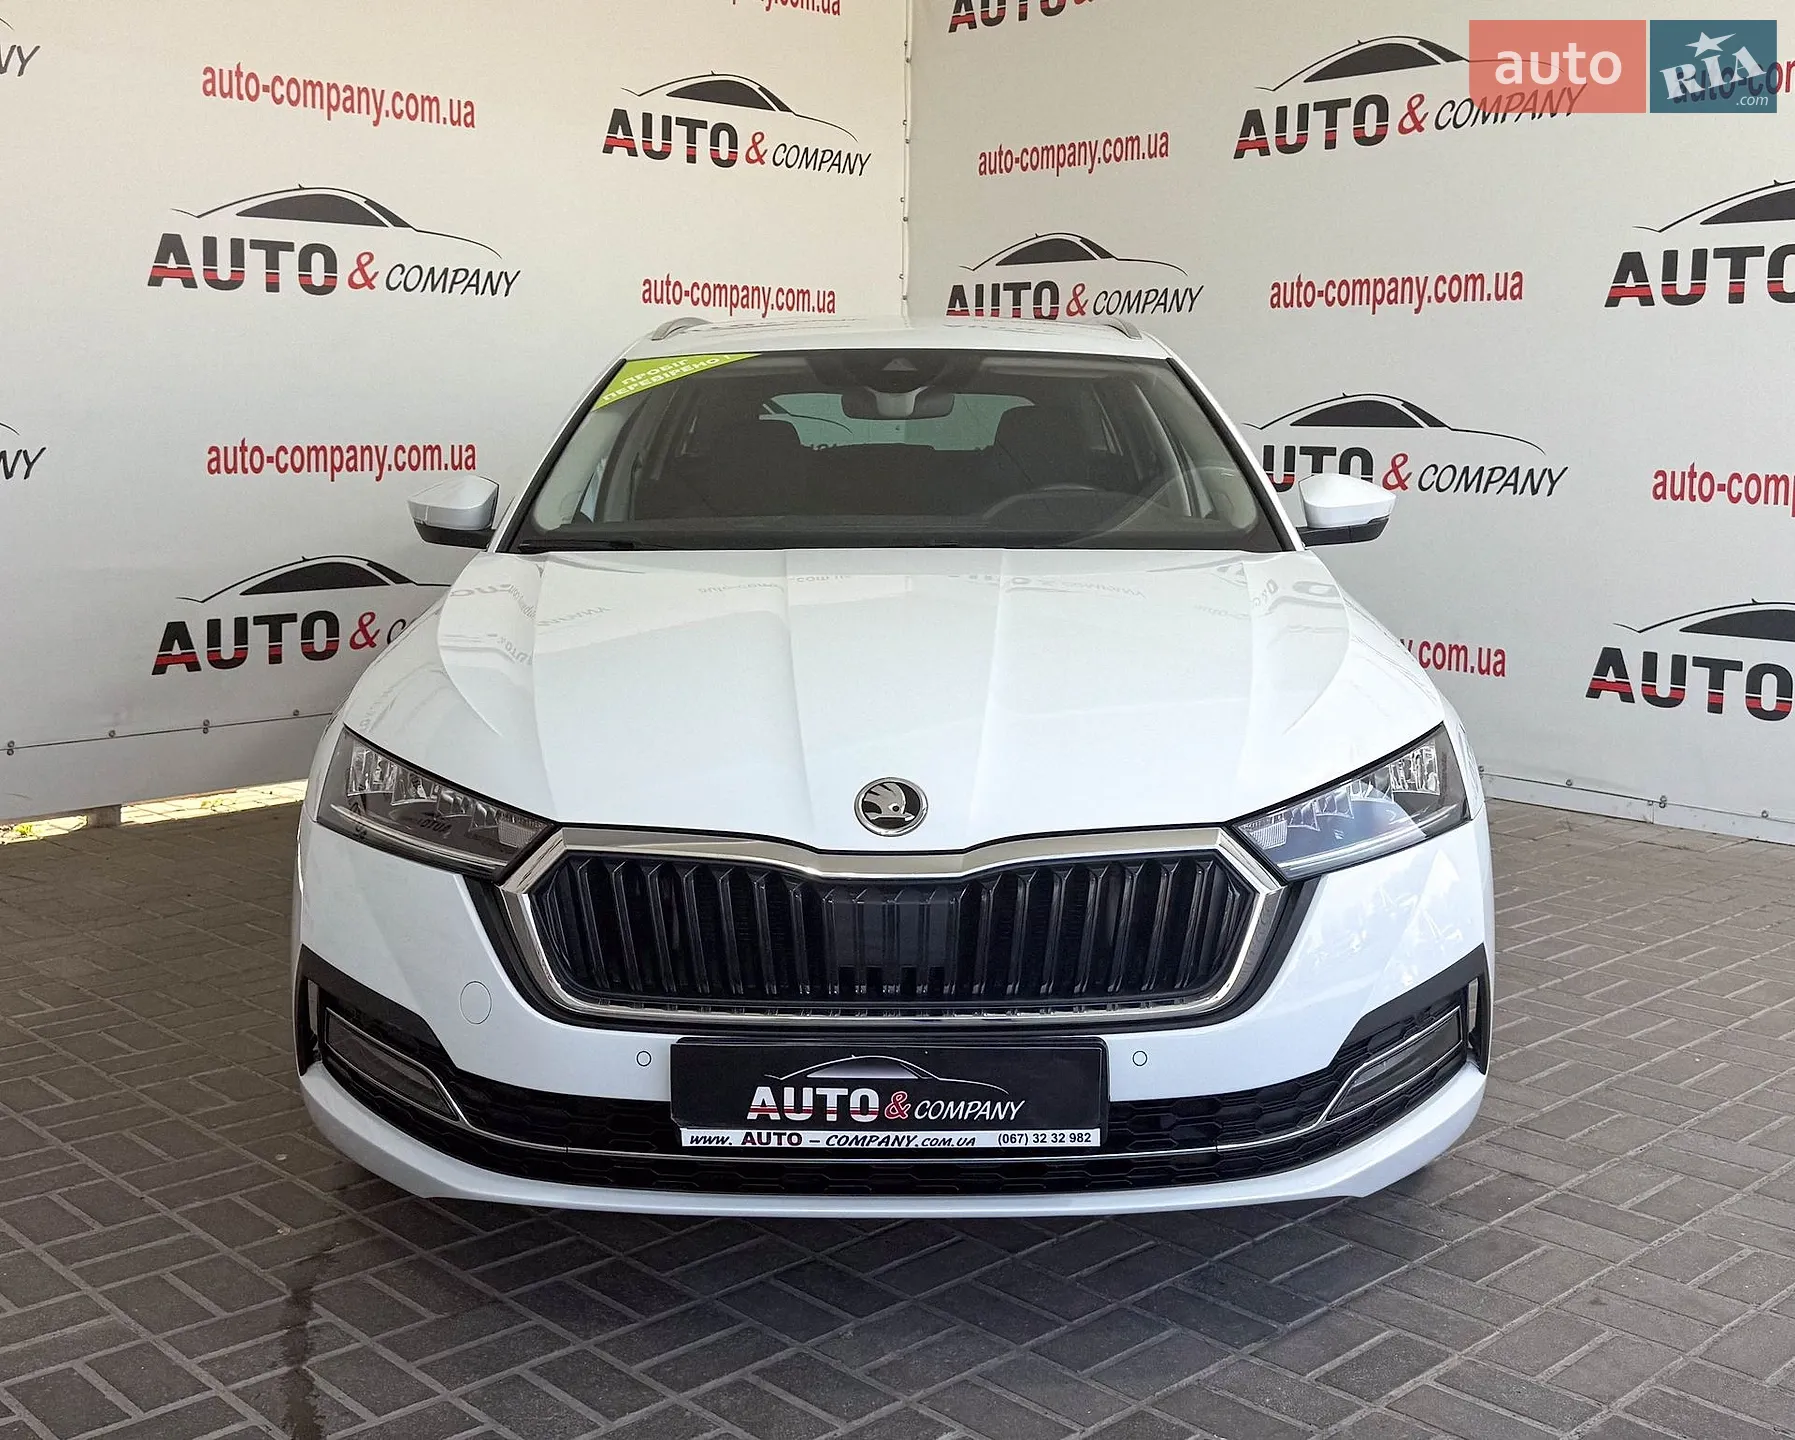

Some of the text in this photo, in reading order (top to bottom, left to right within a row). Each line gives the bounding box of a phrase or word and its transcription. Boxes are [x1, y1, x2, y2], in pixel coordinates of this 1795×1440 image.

[203, 62, 475, 128] auto-company.com.ua
[1233, 83, 1588, 160] AUTO & COMPANY
[602, 108, 871, 177] AUTO & COMPANY
[978, 131, 1169, 177] auto-company.com.ua
[148, 233, 521, 298] AUTO & COMPANY
[1604, 243, 1795, 307] AUTO
[642, 273, 835, 317] auto-company.com.ua
[946, 280, 1205, 320] AUTO & COMPANY
[1270, 270, 1523, 315] auto-company.com.ua
[207, 438, 477, 481] auto-company.com.ua
[1262, 445, 1568, 498] UTO & COMPANY
[1652, 461, 1795, 518] auto-com
[152, 610, 339, 675] AUTO
[350, 611, 380, 650] &
[1585, 646, 1793, 721] AUTO
[746, 1086, 1025, 1123] AUTO & COMPANY
[741, 1131, 803, 1146] AUTO
[998, 1132, 1092, 1146] (067) 32 32 982
